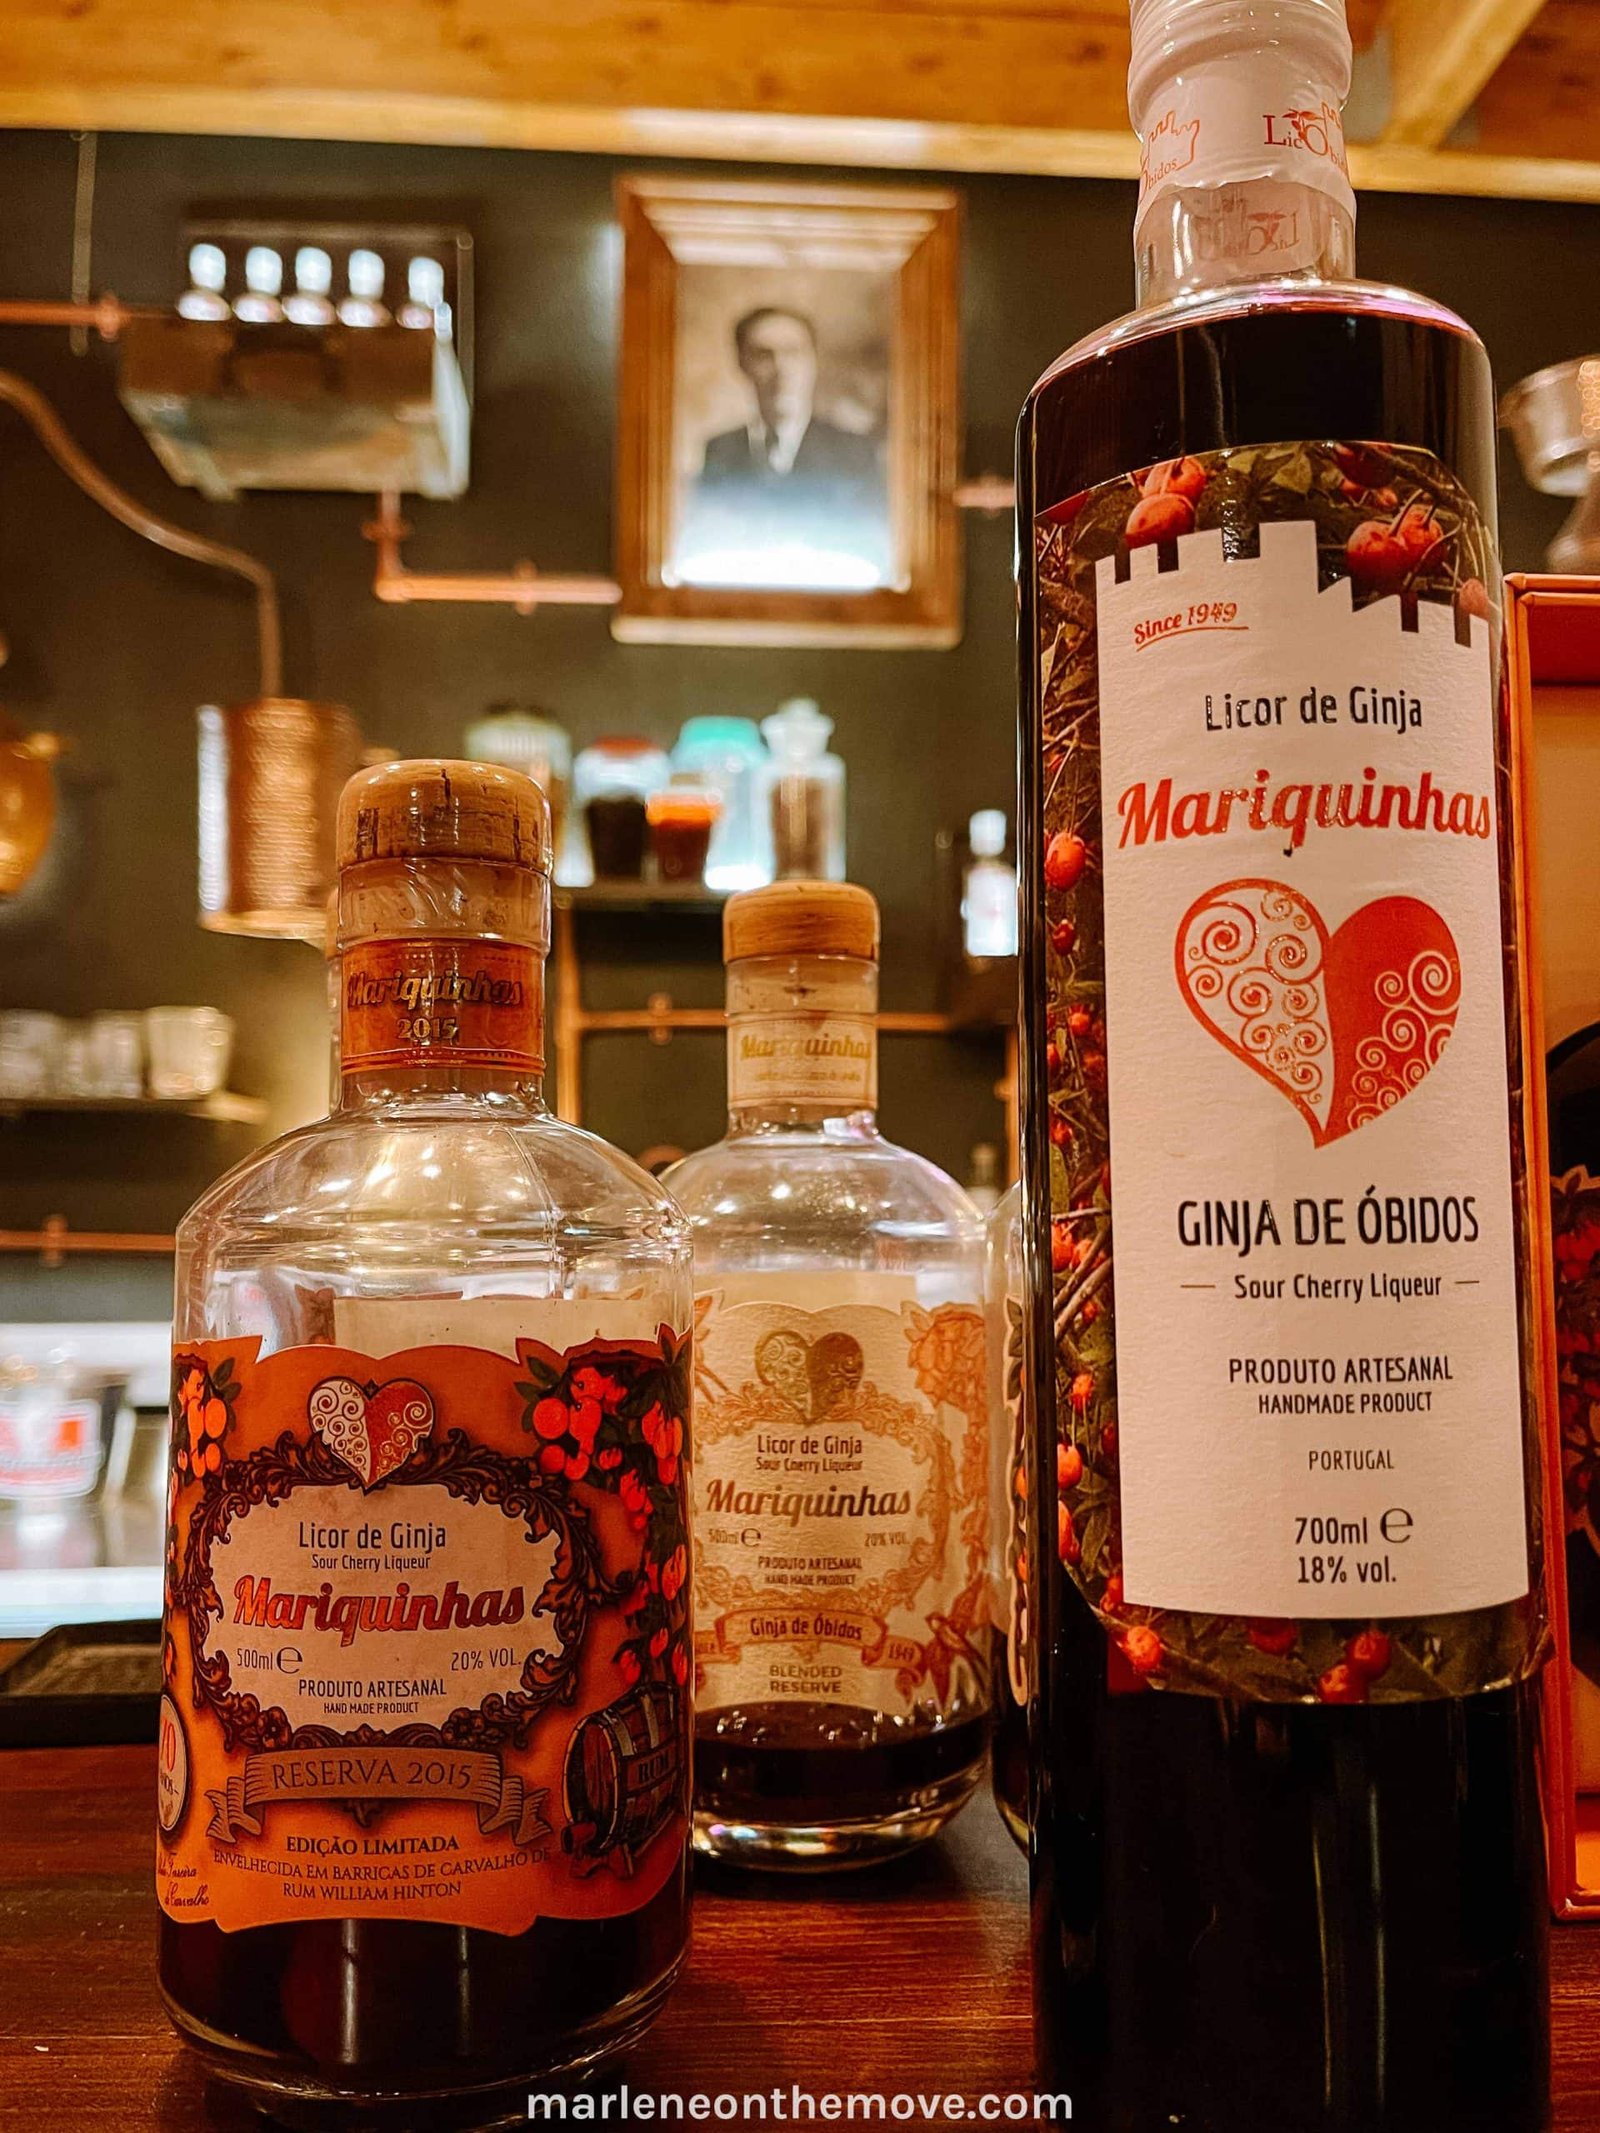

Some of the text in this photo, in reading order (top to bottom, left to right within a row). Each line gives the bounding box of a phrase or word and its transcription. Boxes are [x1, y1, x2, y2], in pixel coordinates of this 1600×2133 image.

[1133, 602, 1237, 645] Since 1949
[1205, 685, 1423, 735] Licor de Ginja
[1117, 766, 1491, 851] Mariquinhas
[347, 969, 523, 1010] Mariquinhas
[396, 1017, 459, 1040] 2015
[1177, 1184, 1480, 1258] GINJA DE ÓBIDOS
[1234, 1272, 1442, 1304] Sour Cherry Liqueur
[1228, 1355, 1454, 1384] PRODUTO ARTESANAL
[1258, 1391, 1433, 1415] HANDMADE PRODUCT
[757, 1434, 863, 1458] Licor de Ginja
[756, 1457, 781, 1471] Sour
[822, 1457, 863, 1473] Liqueur
[1308, 1449, 1395, 1471] PORTUGAL
[706, 1478, 911, 1528] Mariquinhas
[298, 1521, 447, 1554] Licor de Ginja
[1294, 1516, 1368, 1545] 700ml
[311, 1554, 431, 1574] Sour Cherry Liqueur
[758, 1556, 863, 1570] PRODUTO ARTESANAL
[1297, 1555, 1397, 1585] 18% vol.
[233, 1574, 526, 1648] Mariquinhas
[750, 1613, 863, 1640] Ginja de Óbidos
[236, 1647, 274, 1671] 500ml
[450, 1647, 523, 1672] 20% VOL.
[769, 1665, 843, 1680] BLENDED
[298, 1678, 448, 1698] PRODUTO ARTESANAL
[770, 1680, 842, 1694] RESERVE
[323, 1701, 419, 1715] HAND MADE PRODUCT
[272, 1758, 473, 1790] RESERVA 2015
[286, 1834, 460, 1858] EDIÇÃO LIMITADA
[212, 1848, 303, 1878] ENVELHECIDA
[306, 1864, 330, 1880] EM
[333, 1864, 409, 1882] BARRICAS
[412, 1864, 436, 1880] DE
[442, 1852, 529, 1877] CARVALHO
[531, 1847, 551, 1865] DE
[282, 1881, 461, 1902] RUM WILLIAM HINTON
